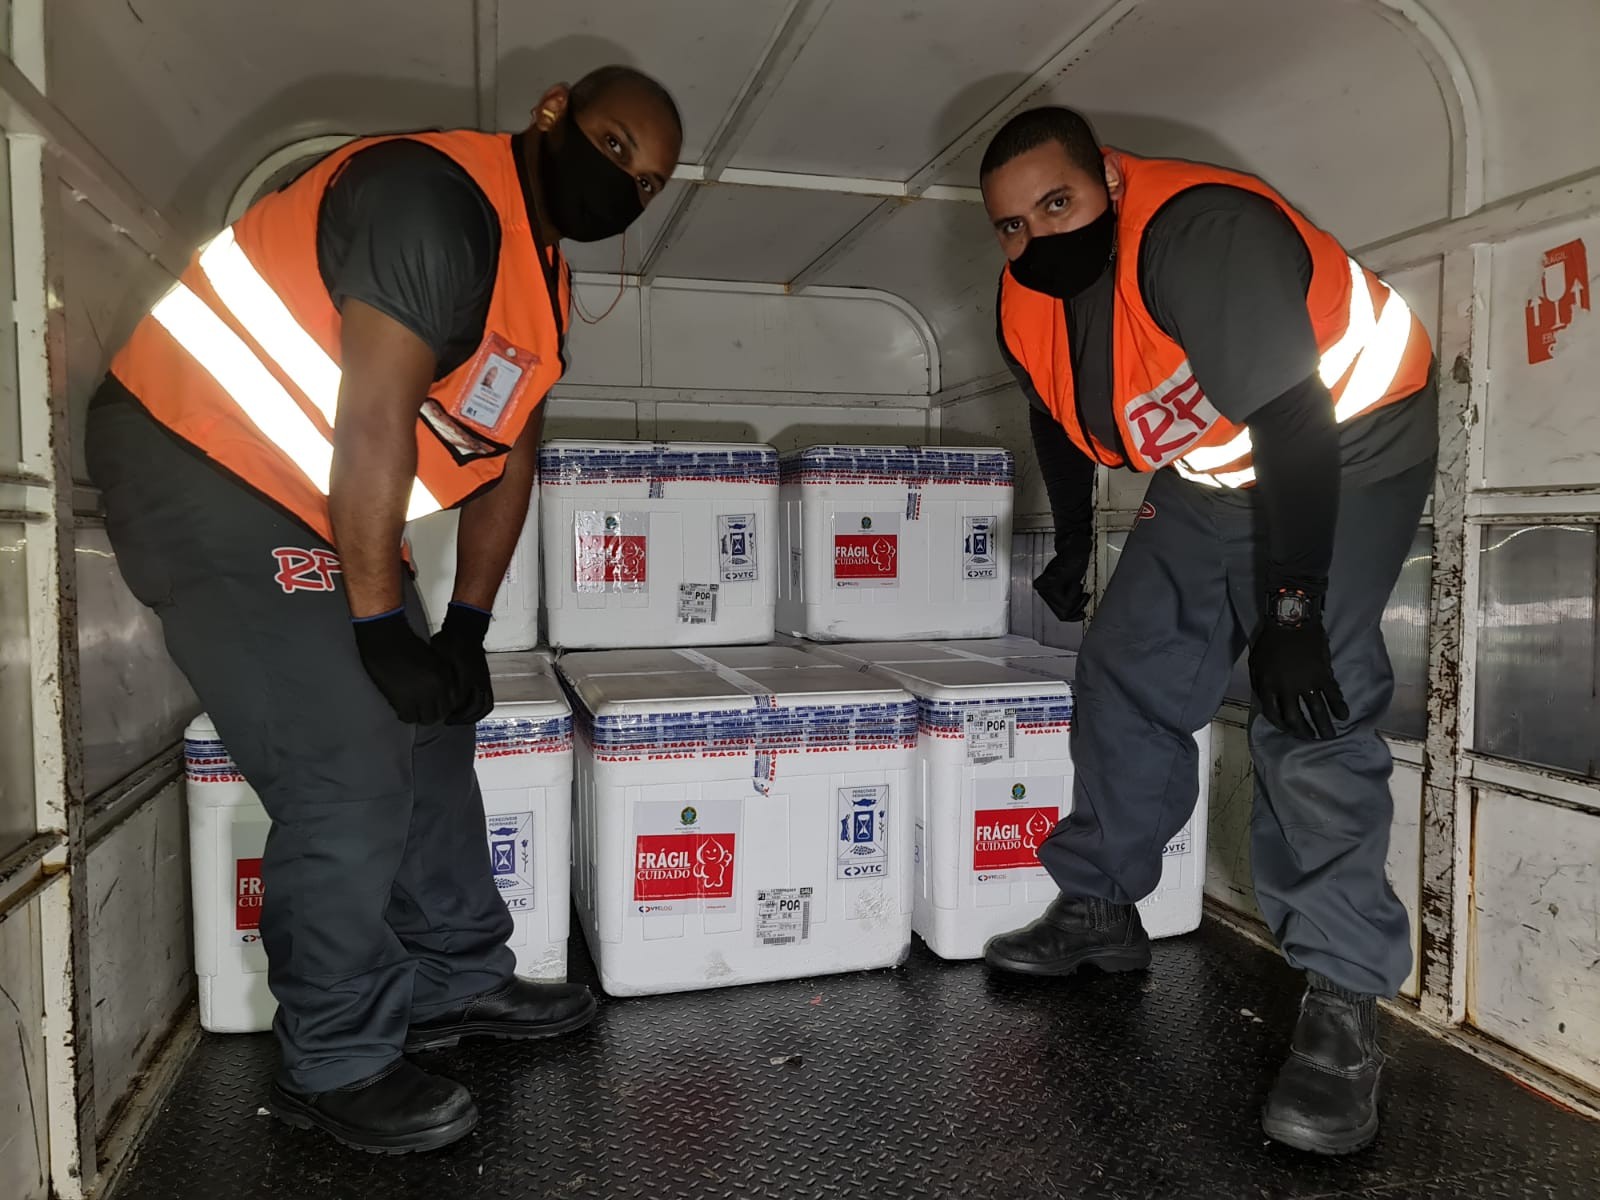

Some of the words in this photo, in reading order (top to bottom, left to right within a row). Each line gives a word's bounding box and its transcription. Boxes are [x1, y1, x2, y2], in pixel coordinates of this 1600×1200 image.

[836, 544, 869, 558] FRÁGIL
[695, 592, 711, 600] POA
[986, 720, 1006, 732] POA
[714, 738, 756, 746] FRÁGIL
[648, 752, 695, 760] FRÁGIL
[976, 821, 1021, 840] FRÁGIL
[976, 840, 1021, 851] CUIDADO
[638, 848, 691, 868] FRÁGIL
[637, 869, 690, 880] CUIDADO
[240, 877, 266, 895] FR
[780, 900, 800, 911] POA
